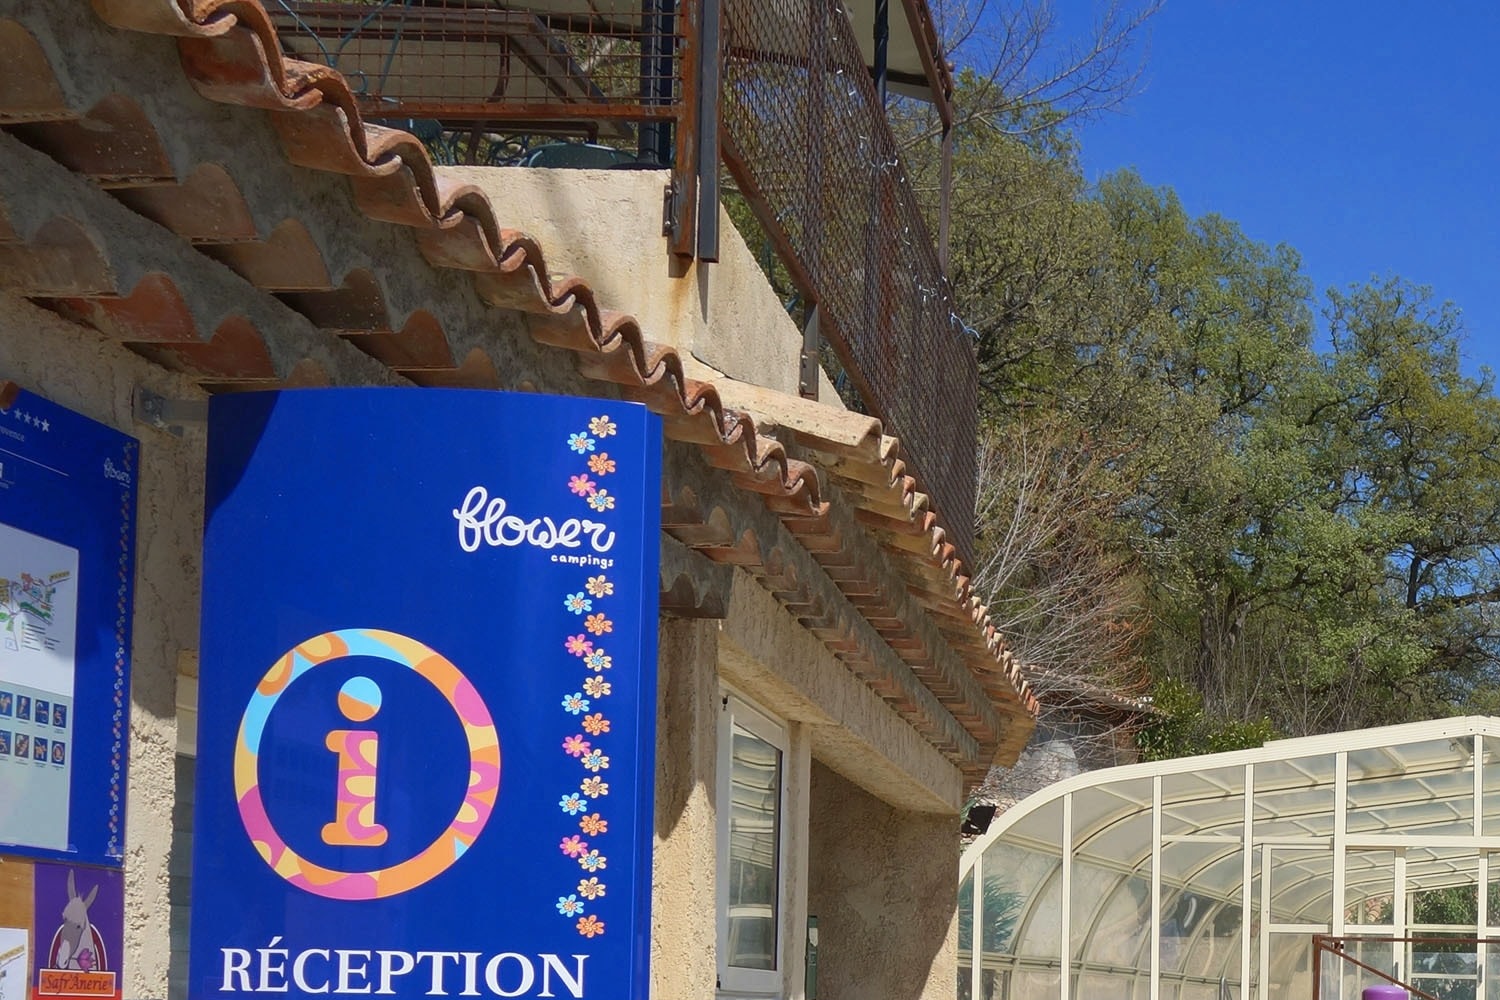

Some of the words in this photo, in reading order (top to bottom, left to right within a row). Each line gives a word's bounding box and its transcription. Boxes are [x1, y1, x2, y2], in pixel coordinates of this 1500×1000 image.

[453, 486, 616, 553] flower
[551, 554, 615, 570] campings
[219, 937, 590, 999] RÉCEPTION
